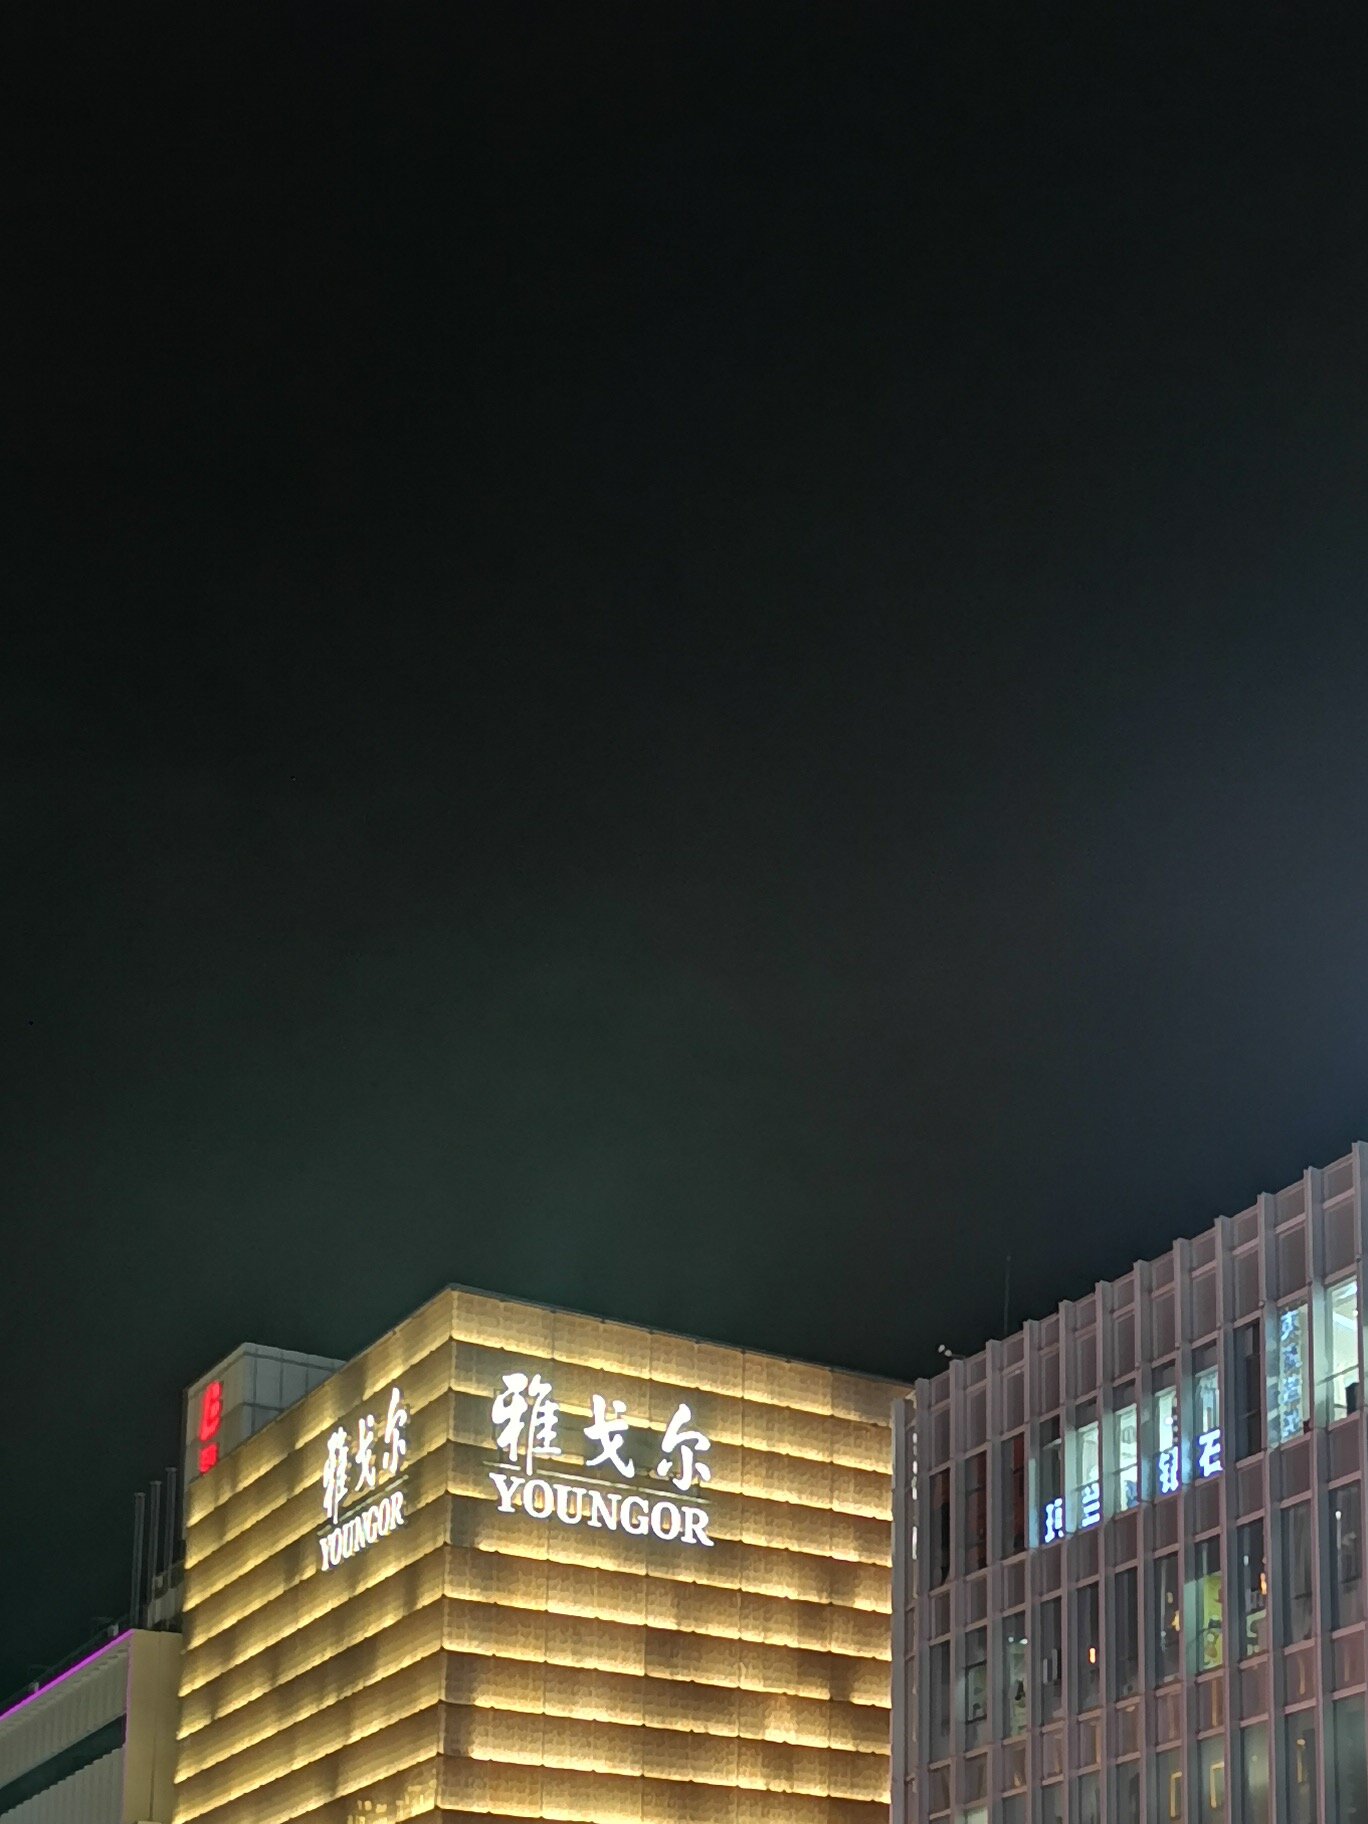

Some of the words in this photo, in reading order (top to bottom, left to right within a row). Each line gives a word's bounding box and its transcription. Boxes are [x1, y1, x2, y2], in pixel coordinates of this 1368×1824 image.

[323, 1387, 408, 1525] 雅戈尔
[492, 1373, 711, 1491] 雅戈尔
[319, 1491, 405, 1571] YOUNGOR
[489, 1472, 714, 1547] YOUNGOR
